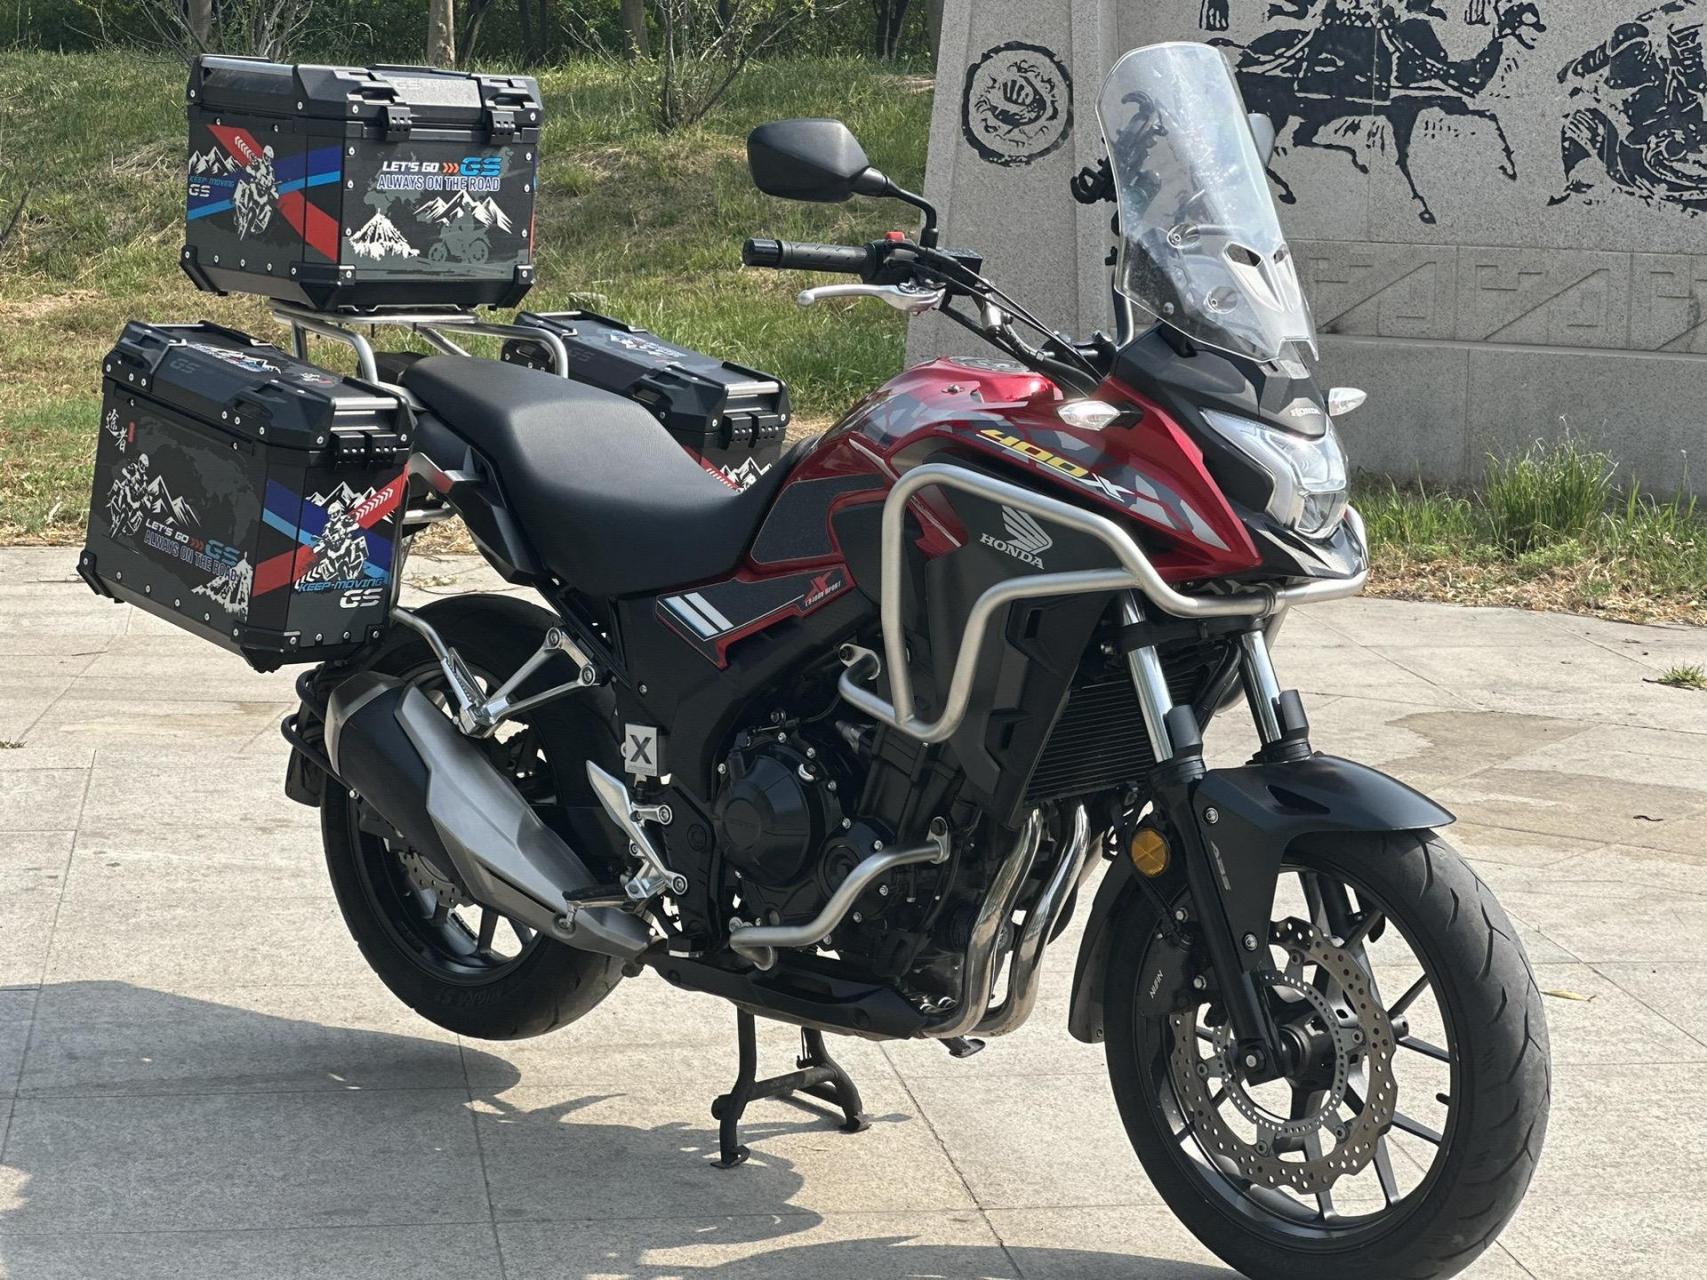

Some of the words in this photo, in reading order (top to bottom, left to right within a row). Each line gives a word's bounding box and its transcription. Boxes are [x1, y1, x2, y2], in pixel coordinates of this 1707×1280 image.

[382, 161, 419, 172] LET'S
[421, 162, 440, 173] GO
[460, 157, 502, 176] GS
[189, 184, 210, 197] GS
[377, 174, 424, 190] ALWAYS
[426, 175, 442, 190] ON
[443, 175, 467, 190] THE
[468, 176, 500, 191] ROAD
[1290, 407, 1321, 417] HONDA
[145, 519, 173, 537] LET'S
[175, 531, 190, 543] GO
[205, 539, 240, 567] GS
[980, 533, 1045, 570] HONDA
[143, 529, 179, 557] ALWAYS
[180, 545, 194, 564] ON
[194, 551, 213, 573] THE
[212, 559, 237, 581] ROAD
[340, 588, 383, 608] GS
